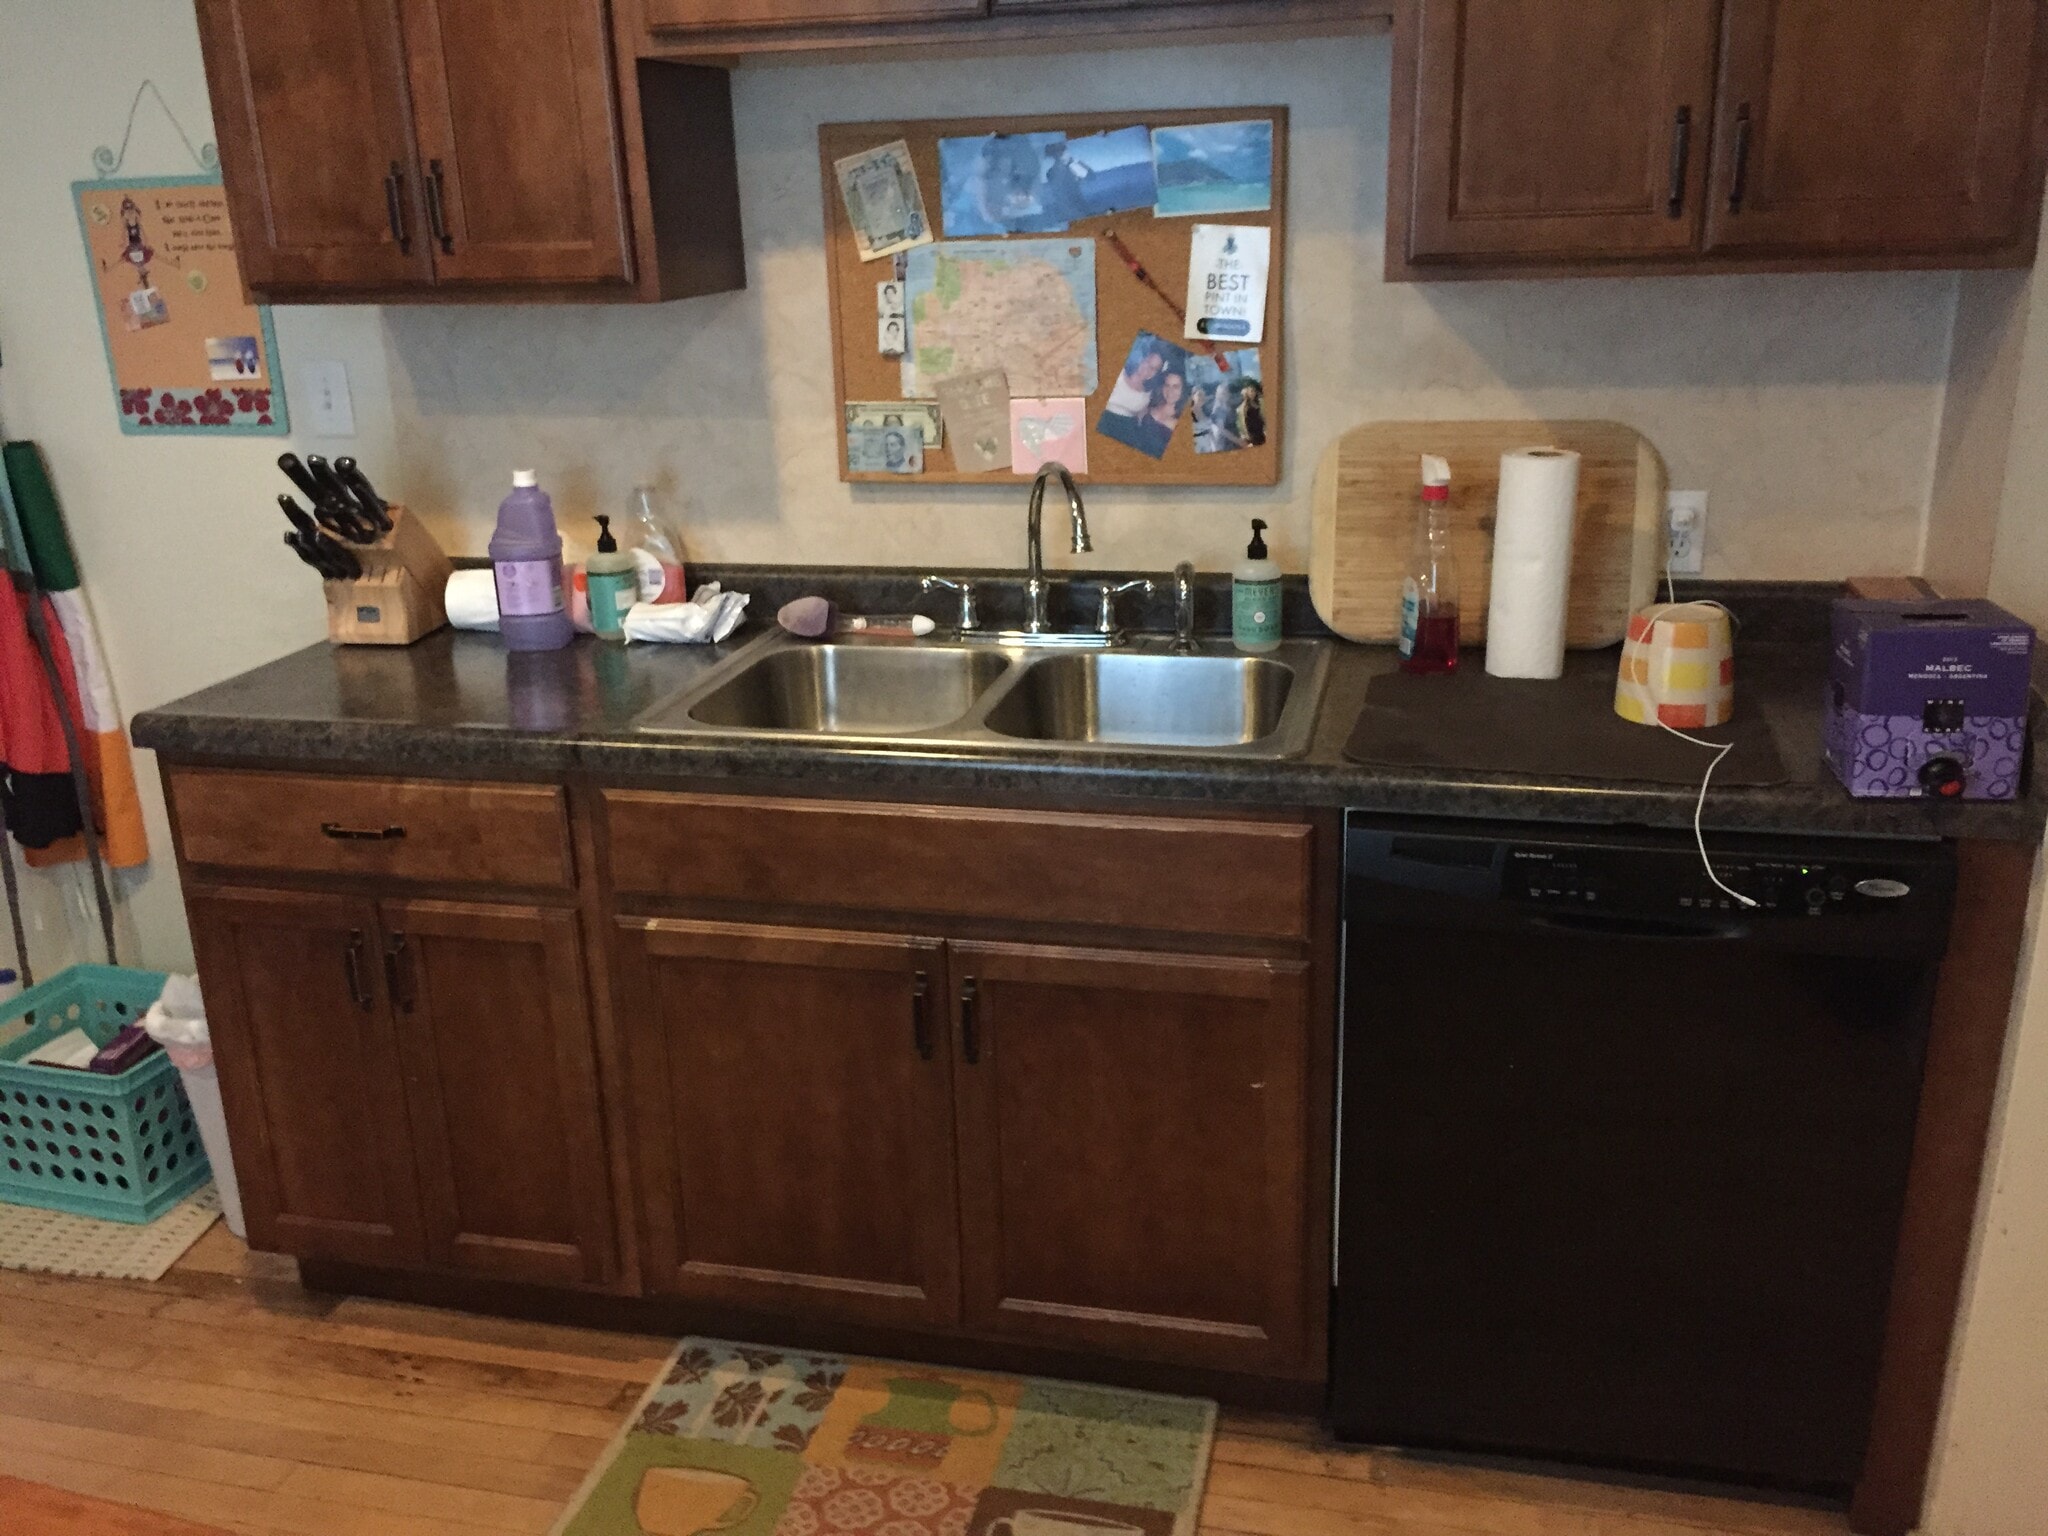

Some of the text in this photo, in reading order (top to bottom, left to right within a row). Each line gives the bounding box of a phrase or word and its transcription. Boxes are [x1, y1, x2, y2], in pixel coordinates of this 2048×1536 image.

[1218, 258, 1240, 270] THE
[1207, 273, 1249, 290] BEST
[1205, 291, 1248, 304] PINT IN
[1925, 664, 1973, 672] MALBEC
